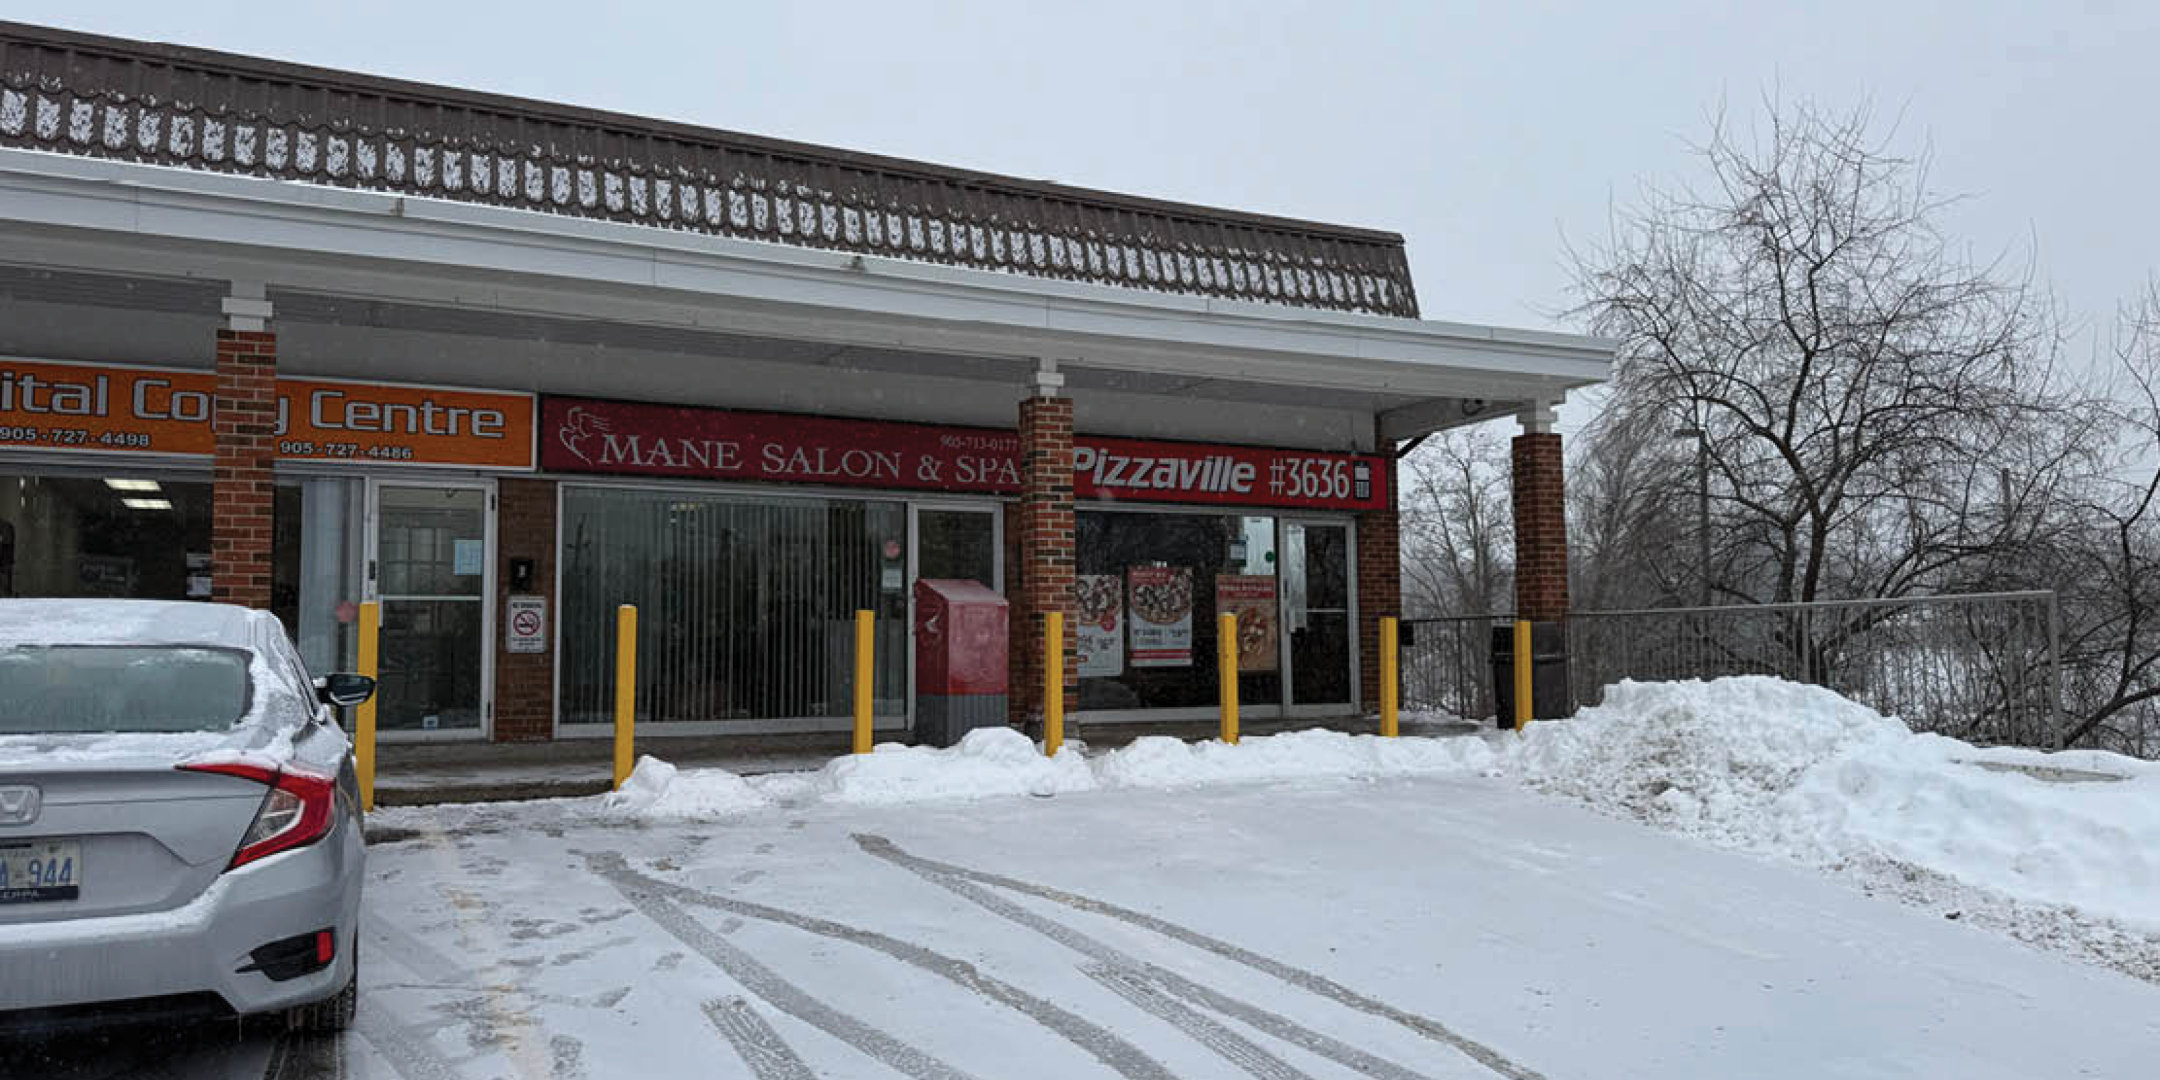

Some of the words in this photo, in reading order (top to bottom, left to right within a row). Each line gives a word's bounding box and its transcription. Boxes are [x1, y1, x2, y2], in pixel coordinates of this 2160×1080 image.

[1, 370, 109, 417] ital
[310, 389, 505, 439] Centre
[597, 433, 744, 471] MANE
[761, 443, 904, 480] SALON
[916, 453, 944, 483] &
[954, 454, 1022, 486] SPA
[1073, 446, 1256, 494] Pizzaville
[1268, 456, 1351, 499] #3636
